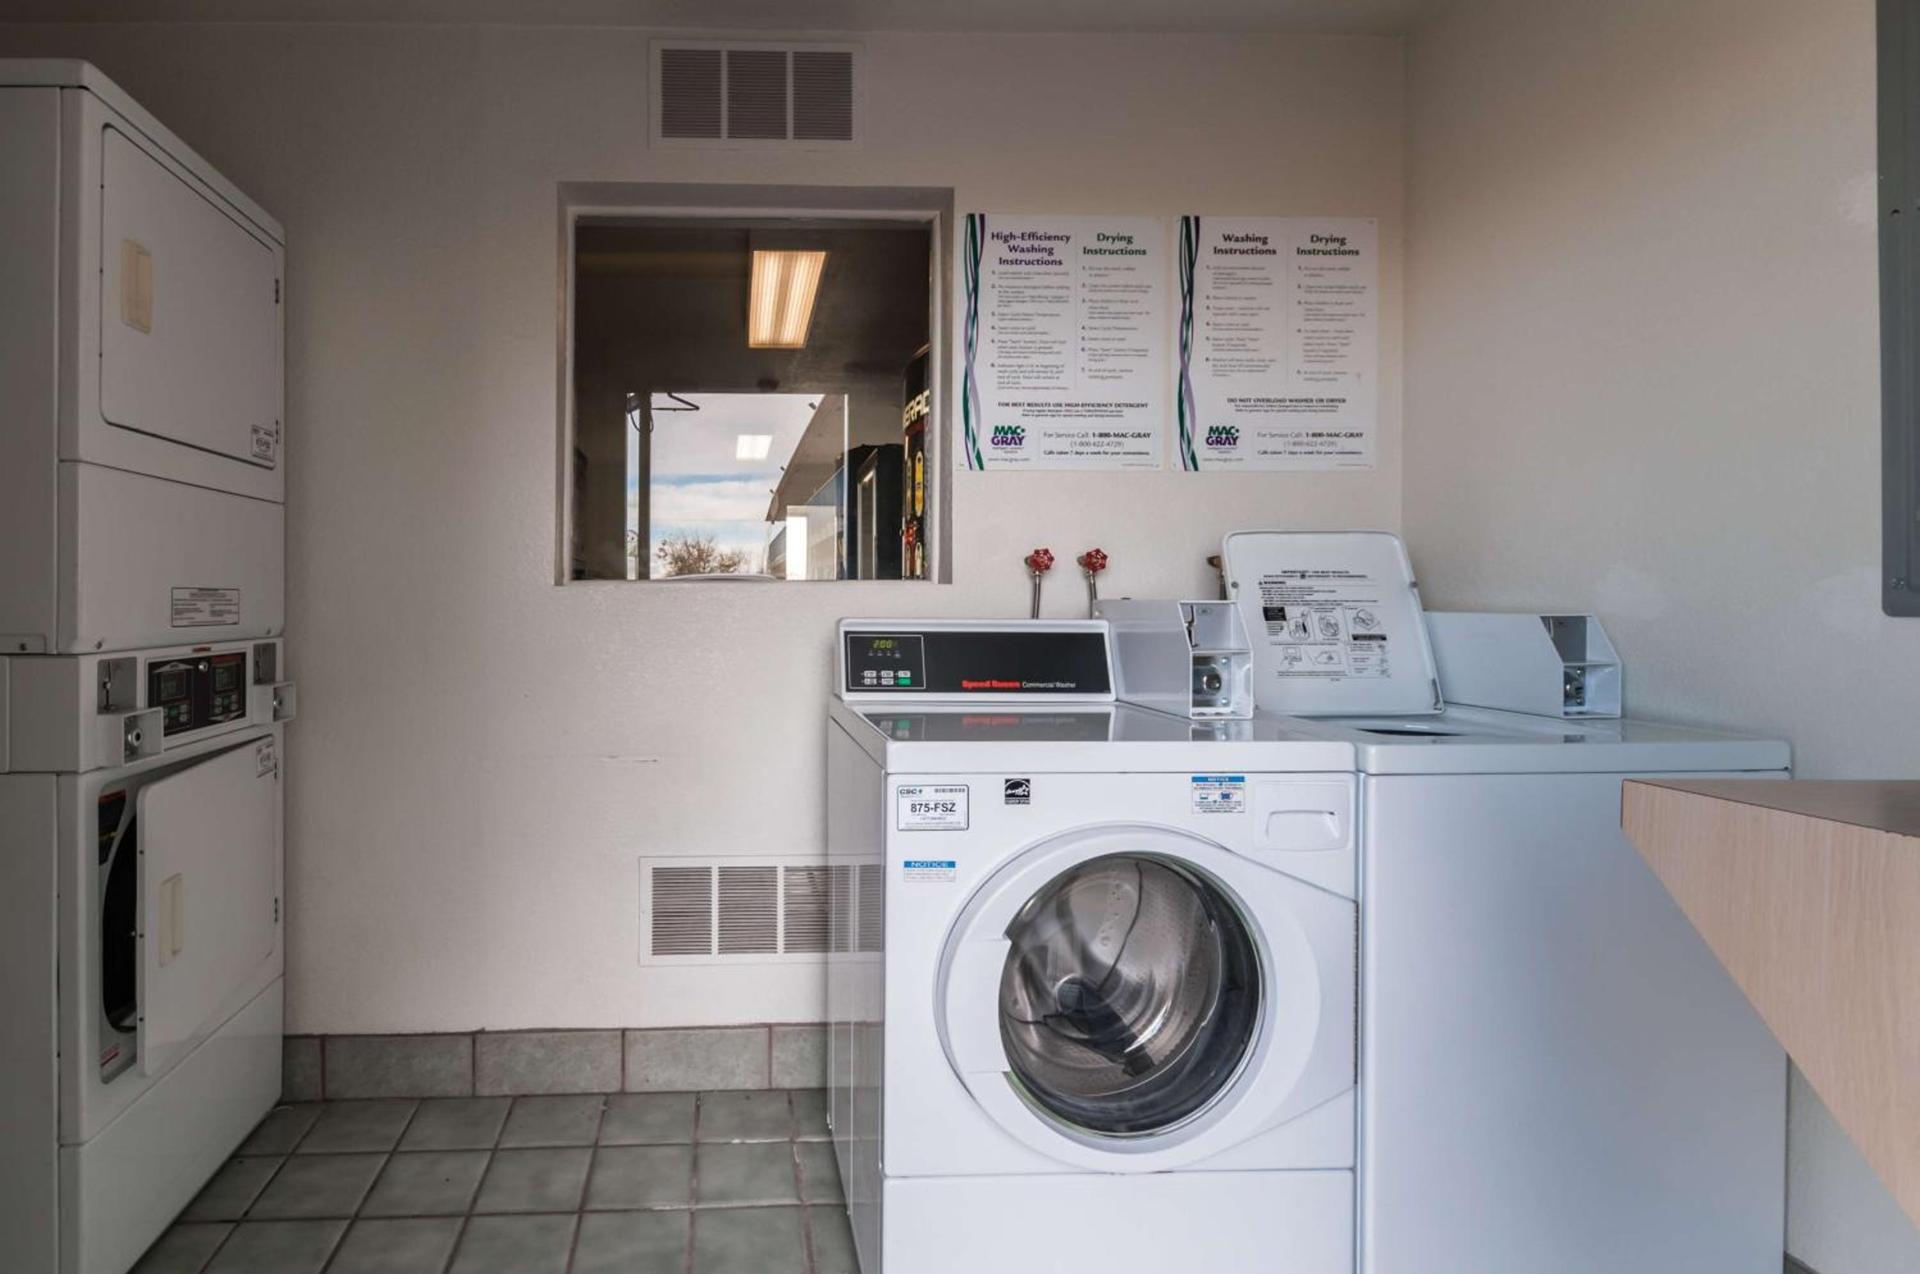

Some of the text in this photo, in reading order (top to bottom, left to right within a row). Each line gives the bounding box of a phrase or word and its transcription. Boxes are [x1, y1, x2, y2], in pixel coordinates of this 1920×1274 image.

[991, 232, 1071, 244] High-Efficiency
[1097, 232, 1133, 245] Drying
[1222, 233, 1268, 245] Washing
[1310, 234, 1347, 246] Drying
[1007, 244, 1054, 256] Washing
[1083, 246, 1147, 256] Instructions
[1213, 246, 1277, 256] Instructions
[1296, 247, 1360, 256] Instructions
[998, 256, 1063, 266] Instructions
[991, 435, 1025, 446] GRAY
[1206, 435, 1239, 446] GRAY
[910, 802, 957, 813] 875-FSZ
